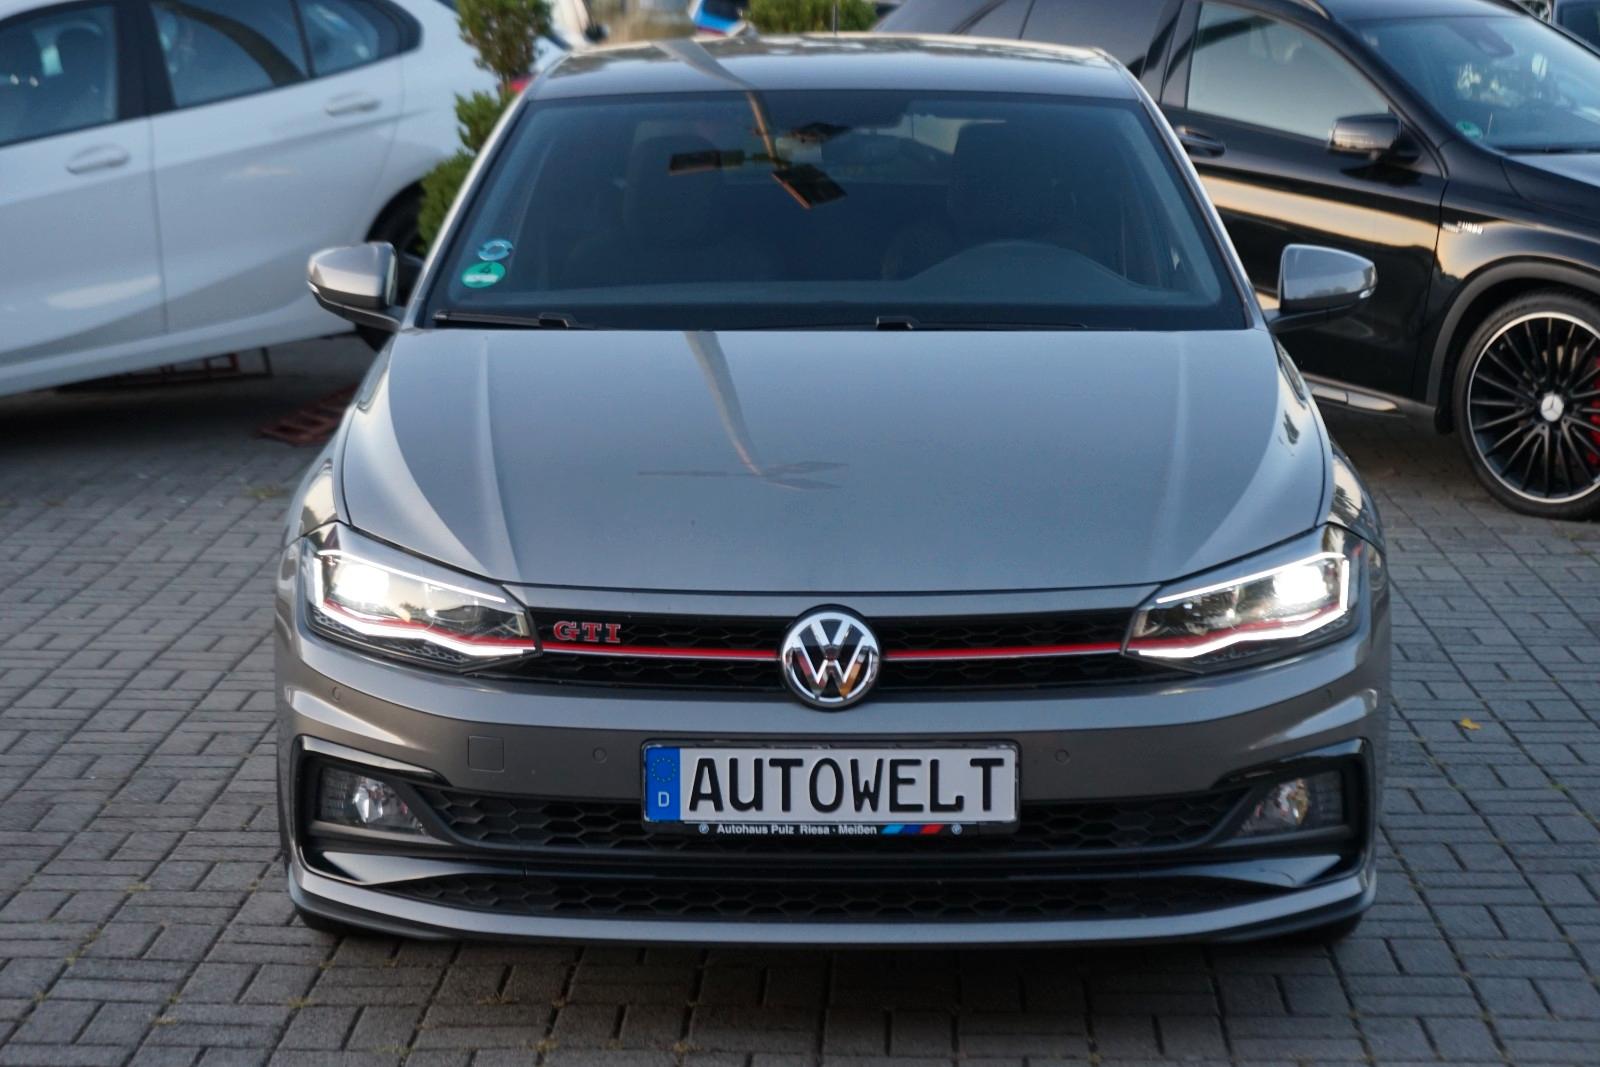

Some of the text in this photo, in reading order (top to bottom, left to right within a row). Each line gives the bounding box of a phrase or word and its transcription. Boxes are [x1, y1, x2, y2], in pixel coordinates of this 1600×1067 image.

[553, 620, 622, 644] GTI
[688, 757, 1005, 814] AUTOWELT
[658, 791, 670, 807] D
[716, 823, 877, 835] Autohaus Pulz Riesa Meißen
